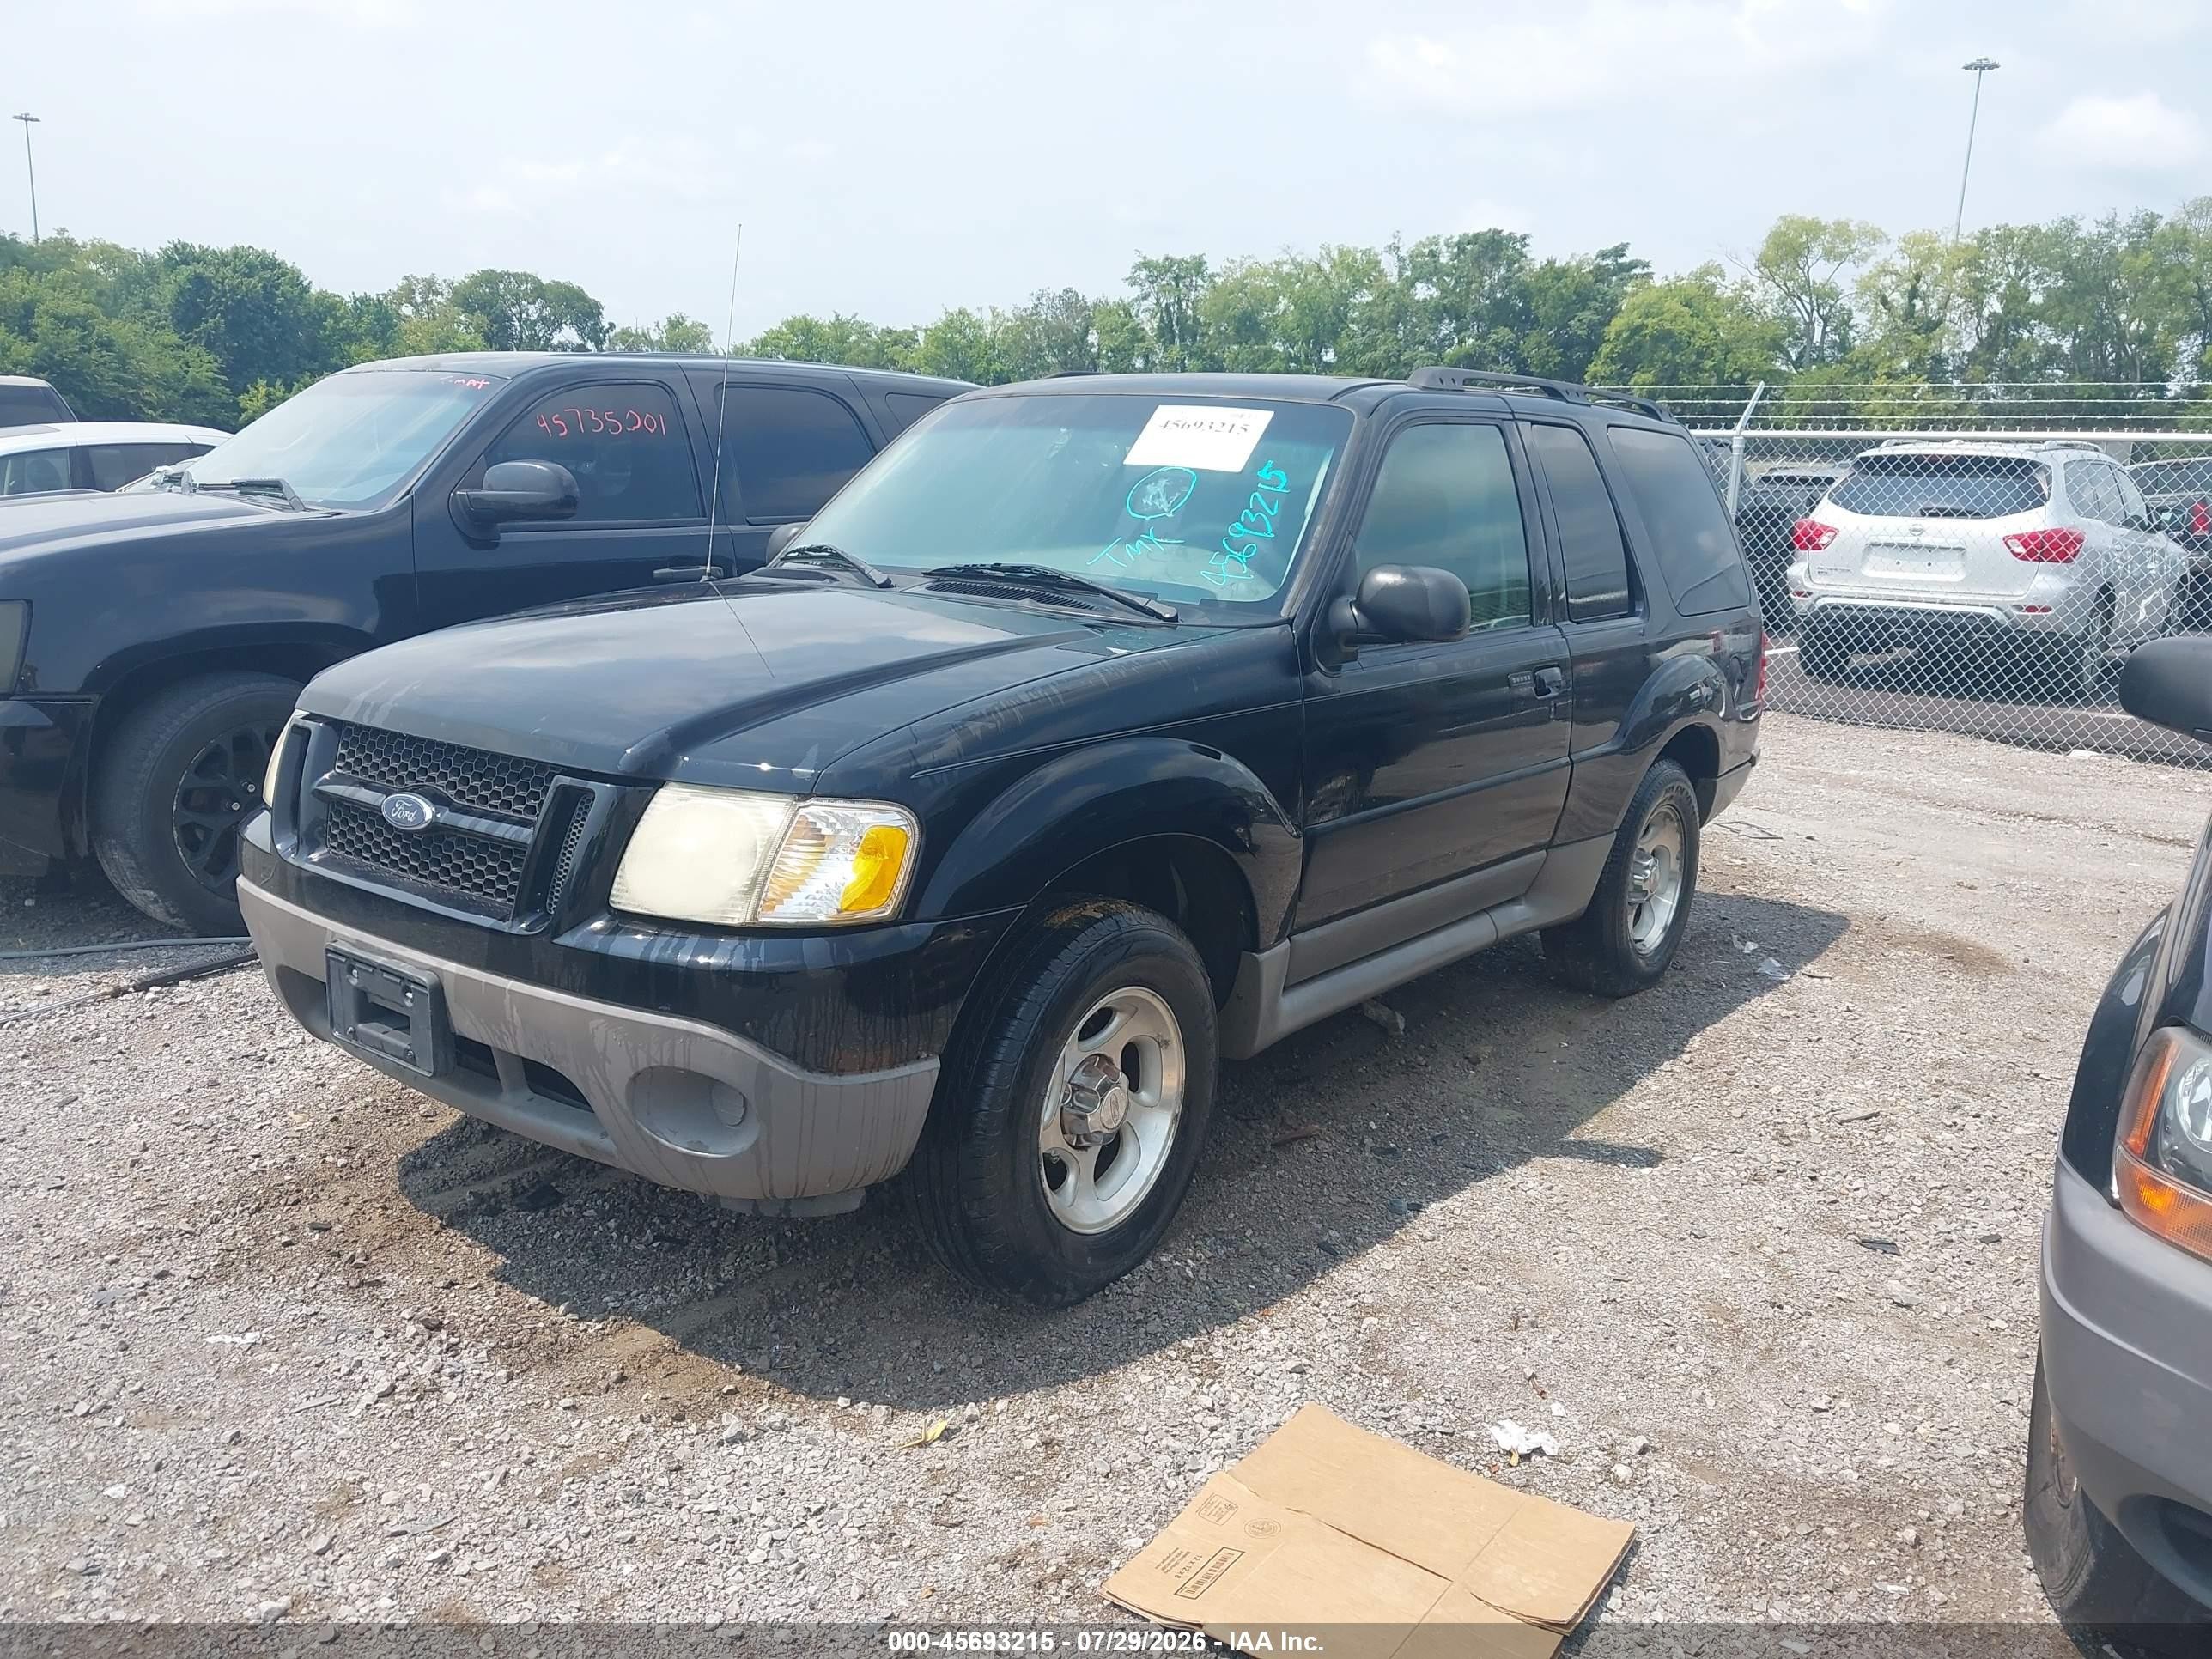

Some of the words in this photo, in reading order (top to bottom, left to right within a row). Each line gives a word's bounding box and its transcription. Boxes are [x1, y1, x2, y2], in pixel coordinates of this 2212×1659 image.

[536, 408, 666, 437] 45735201
[1159, 419, 1252, 434] 45693215
[1200, 459, 1291, 586] 45693215
[392, 799, 418, 822] Ford
